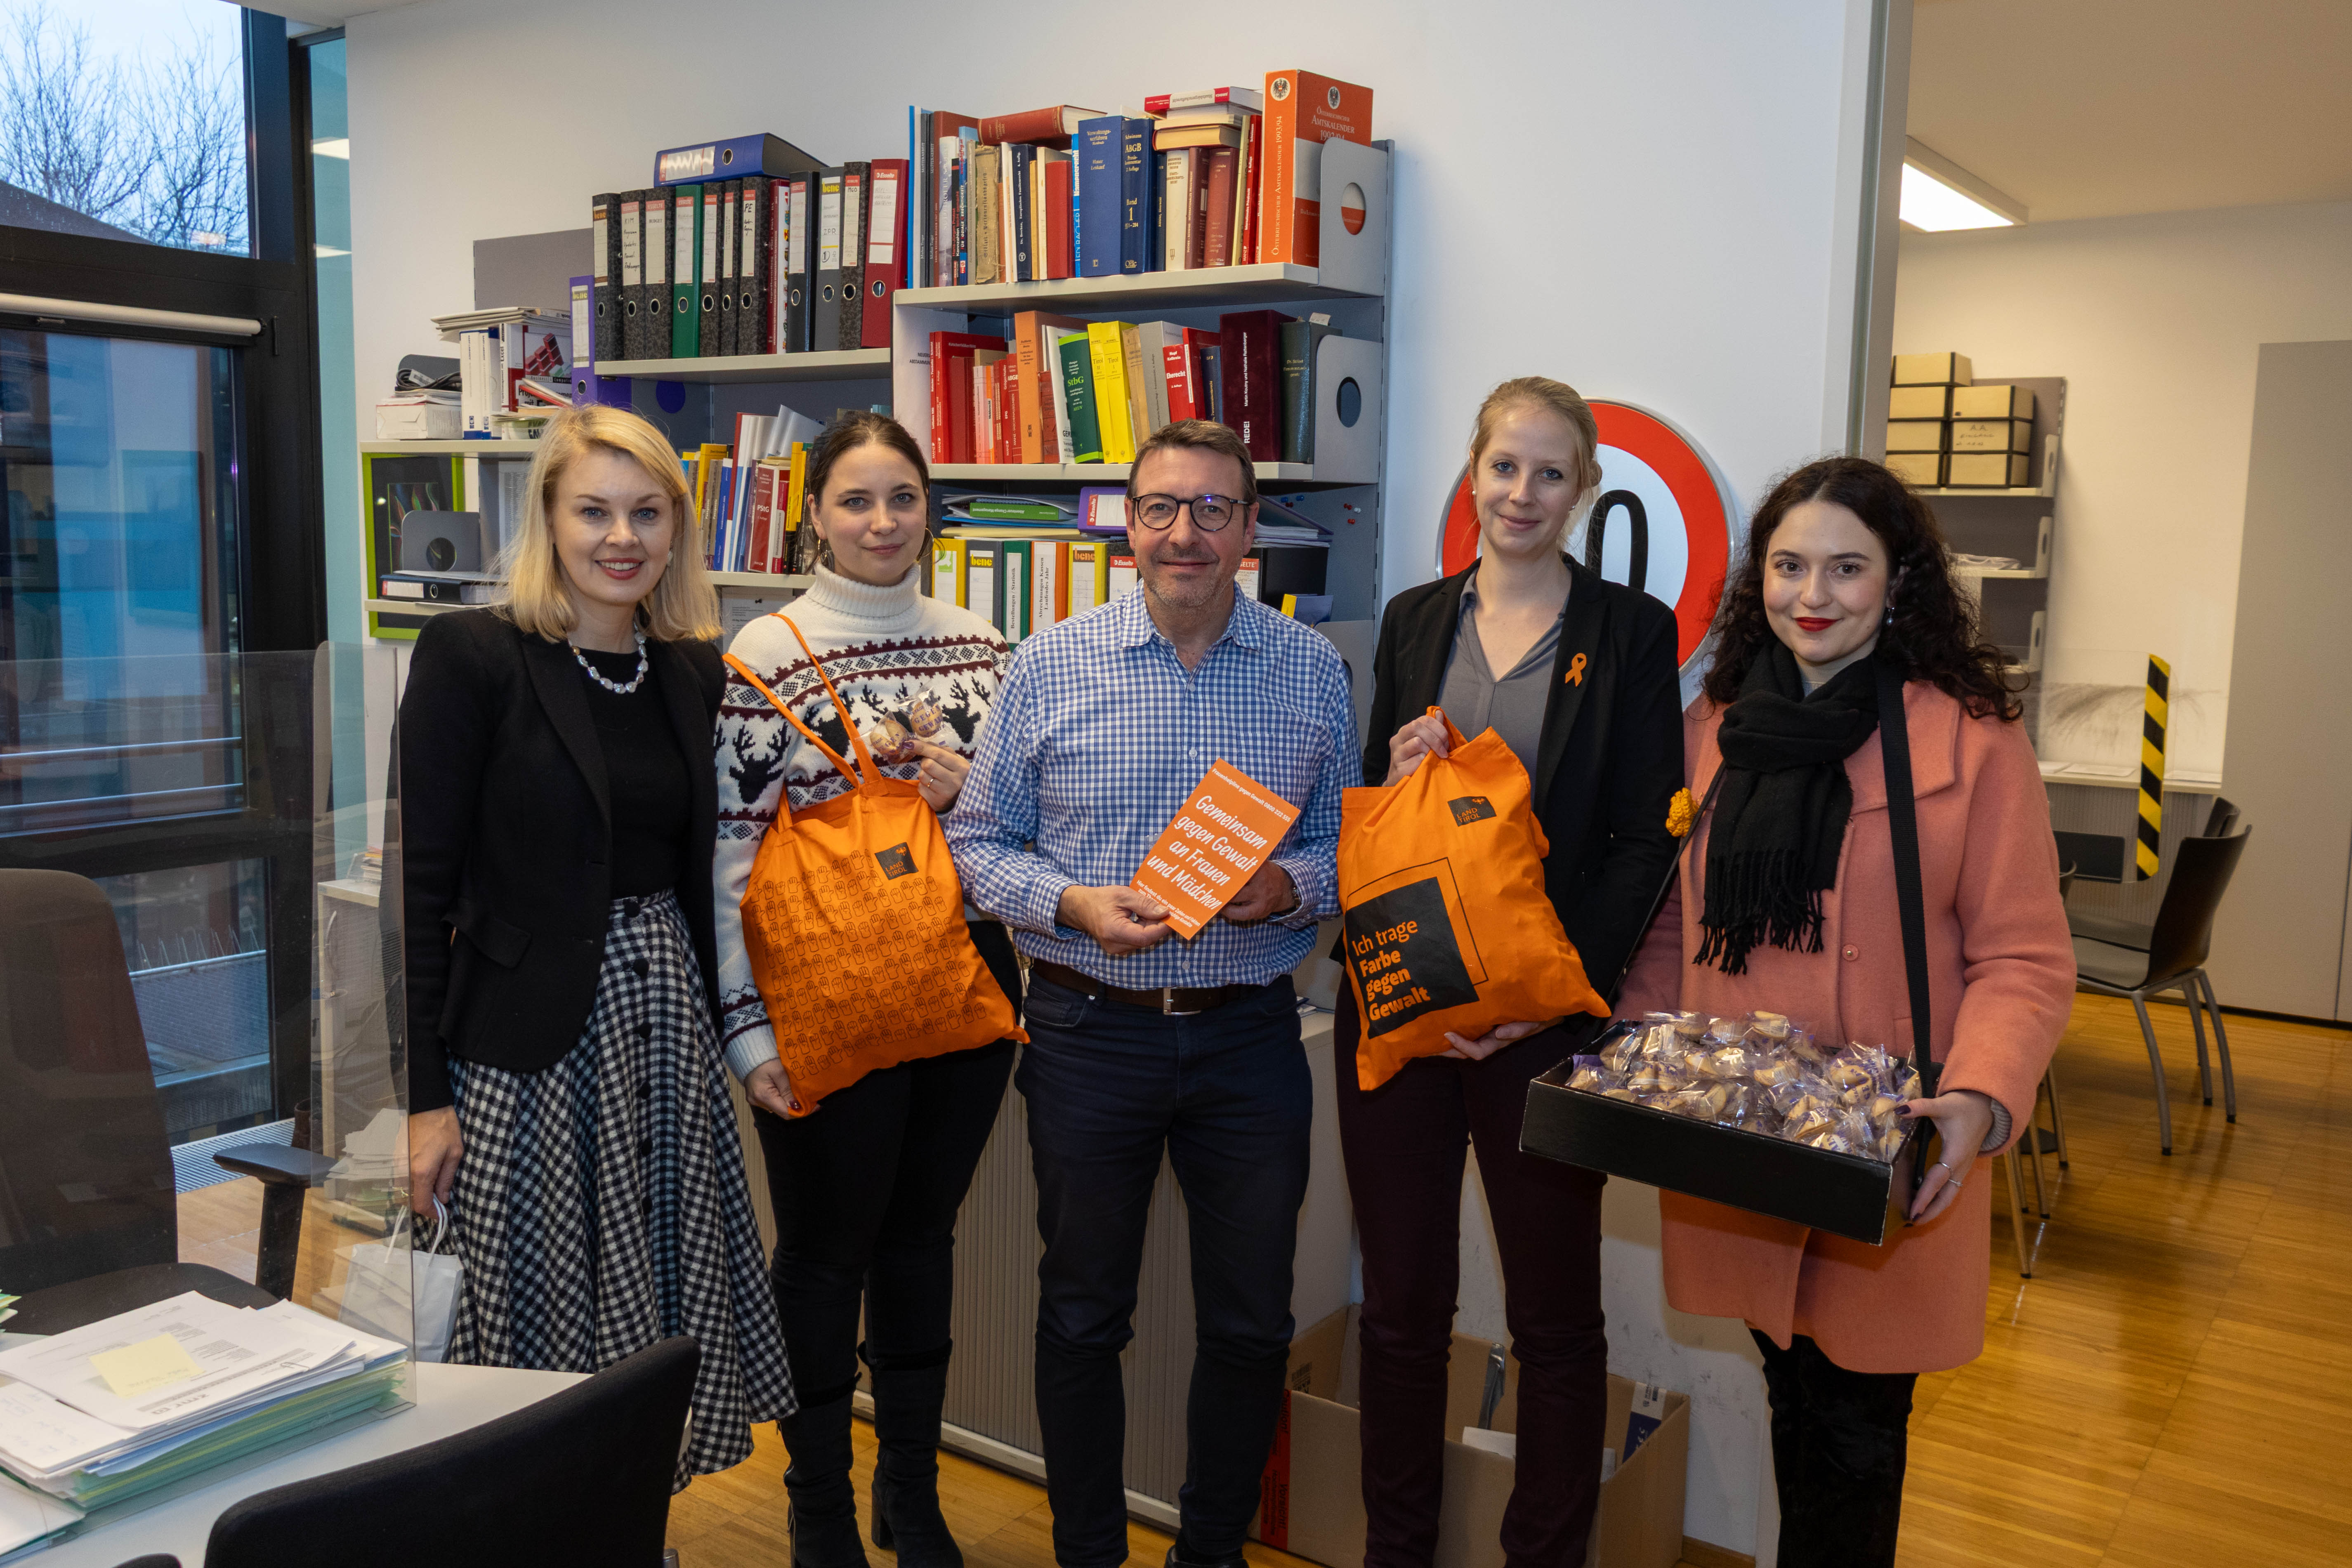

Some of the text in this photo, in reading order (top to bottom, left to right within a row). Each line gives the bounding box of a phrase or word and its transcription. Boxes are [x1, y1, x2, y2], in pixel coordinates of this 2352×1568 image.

[1172, 94, 1213, 103] Staatsbürgerschaftsrecht
[1312, 115, 1355, 133] AMTSKALENDER
[1125, 143, 1142, 153] ABGB
[823, 182, 840, 193] bene
[744, 203, 753, 213] PE
[1129, 207, 1133, 221] 1
[1271, 196, 1281, 255] ÖSTERREICHISCHER
[1068, 376, 1084, 387] StbG
[1166, 370, 1186, 380] Eherecht
[757, 505, 769, 513] PStG
[971, 554, 992, 566] bene
[1074, 548, 1095, 561] bene
[1212, 768, 1291, 823] Frauenhelpline gegen Gewalt 0800 222 555
[1457, 807, 1478, 819] LAND
[1458, 813, 1481, 824] TIROL
[1196, 795, 1268, 850] Gemeinsam
[1174, 816, 1259, 872] gegen Gewalt
[885, 861, 904, 873] LAND
[1169, 841, 1231, 886] an Frauen
[887, 866, 908, 877] TIROL
[1147, 855, 1223, 910] und Mädchen
[1138, 888, 1147, 897] zum
[1136, 879, 1145, 888] Hier
[1143, 884, 1157, 897] findest
[1166, 903, 1177, 911] paar
[1175, 908, 1187, 918] Zahlen
[1189, 917, 1201, 927] Fakten
[1352, 920, 1418, 956] Ich trage
[1359, 950, 1401, 977] Farbe
[1366, 968, 1411, 1002] gegen
[1369, 986, 1431, 1021] Gewalt
[1279, 1484, 1288, 1530] Vorsicht!
